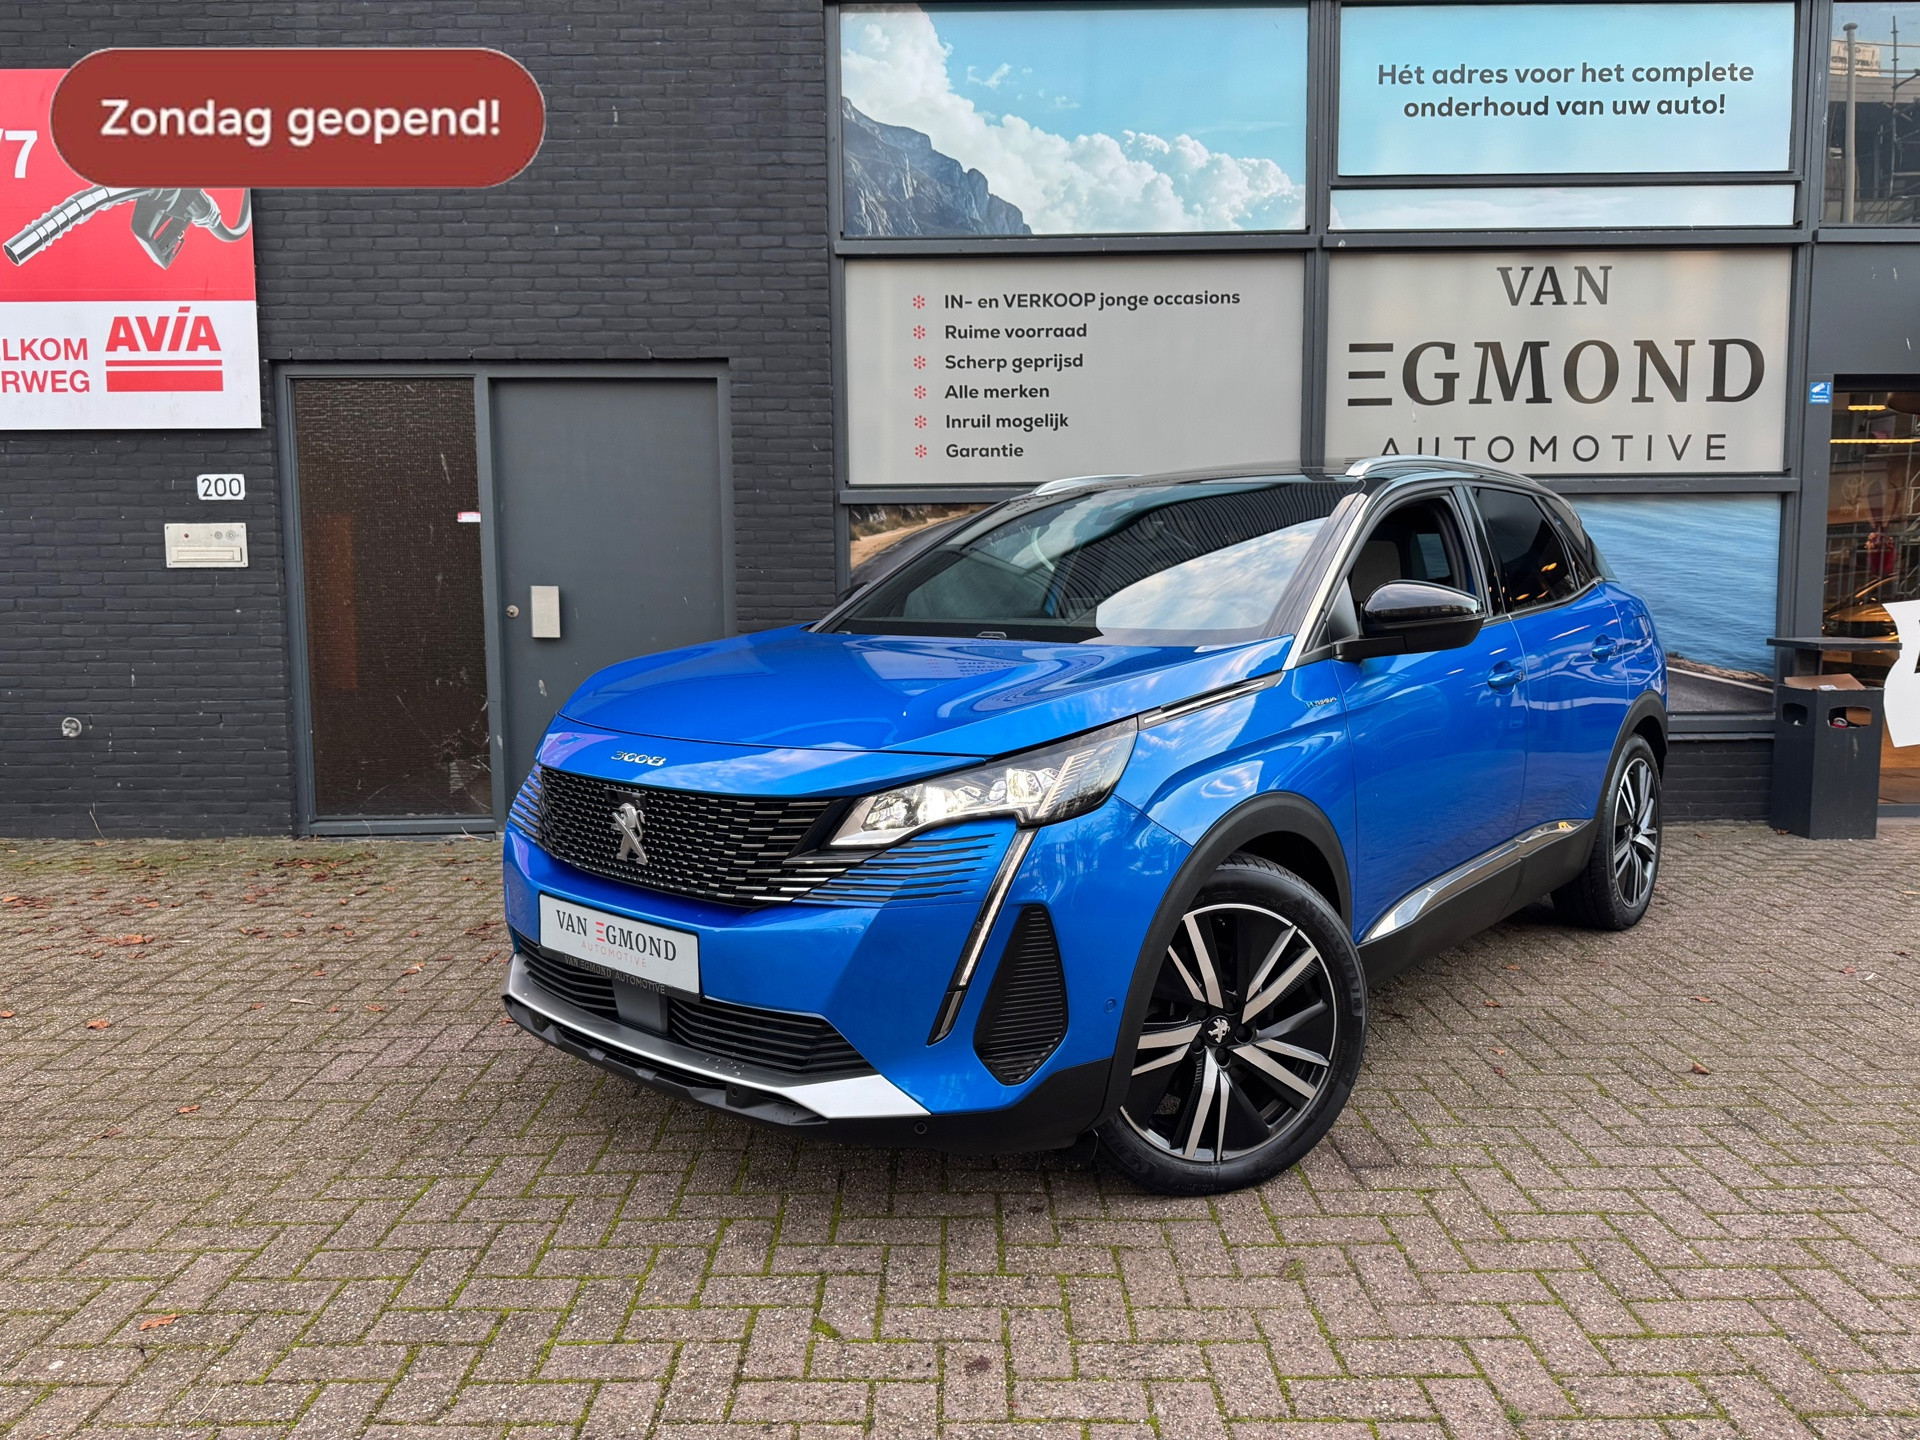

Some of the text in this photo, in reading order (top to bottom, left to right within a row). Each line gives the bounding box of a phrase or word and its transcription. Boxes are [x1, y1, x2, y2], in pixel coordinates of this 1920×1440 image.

[1378, 61, 1754, 88] Hét adres voor het complete
[1403, 94, 1726, 117] onderhoud van uw auto!
[0, 129, 38, 178] 7
[1497, 266, 1612, 307] VAN
[944, 291, 1241, 312] IN- en VERKOOP jonge occasions
[105, 306, 221, 352] AVIA
[945, 323, 1087, 340] Ruime voorraad
[0, 338, 88, 361] LKOM
[945, 353, 1084, 373] Scherp geprijsd
[1347, 338, 1765, 407] EGMOND
[945, 384, 1050, 399] Alle merken
[945, 413, 1069, 433] Inruil mogelijk
[945, 443, 1024, 459] Garantie
[1381, 434, 1727, 462] AUTOMOTIVE
[201, 478, 241, 497] 200
[610, 750, 667, 767] 3008
[556, 909, 677, 961] VAN EGMOND
[581, 940, 647, 968] AUTOMOTIVE
[564, 955, 667, 995] VAN EGMOND AUTOMOTIVE
